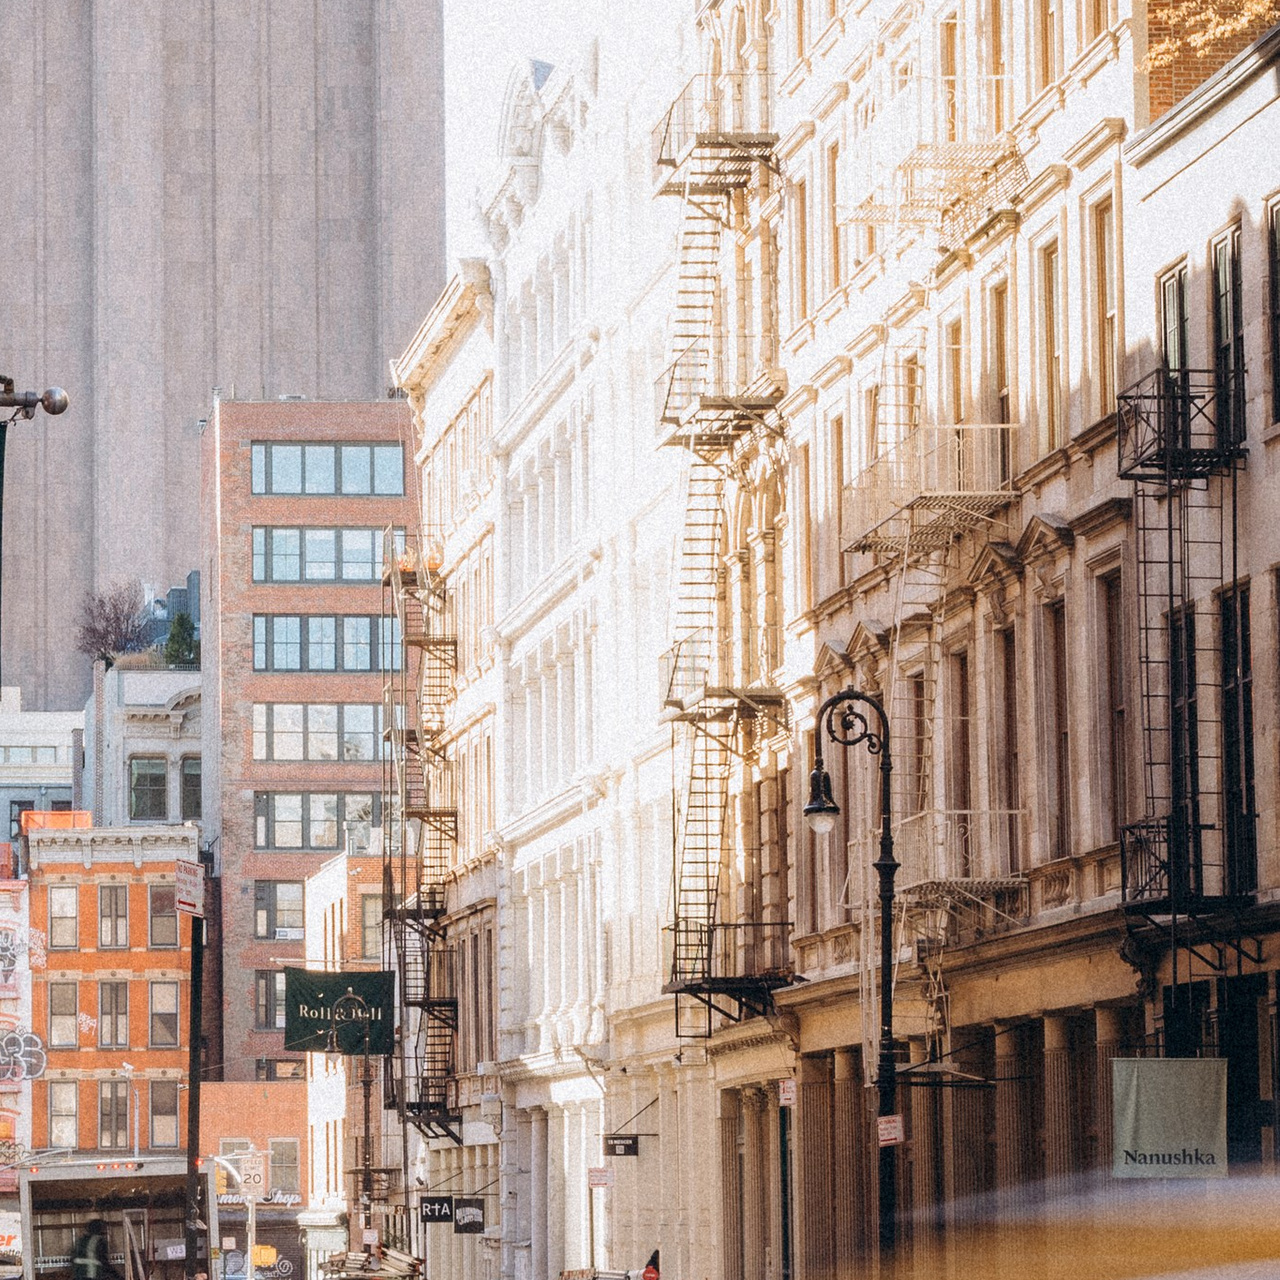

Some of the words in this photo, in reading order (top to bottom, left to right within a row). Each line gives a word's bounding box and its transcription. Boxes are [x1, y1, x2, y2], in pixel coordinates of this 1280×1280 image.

[299, 1004, 331, 1020] Roll
[335, 1008, 347, 1021] &
[1123, 1148, 1216, 1165] Nanushka
[243, 1173, 262, 1184] 20
